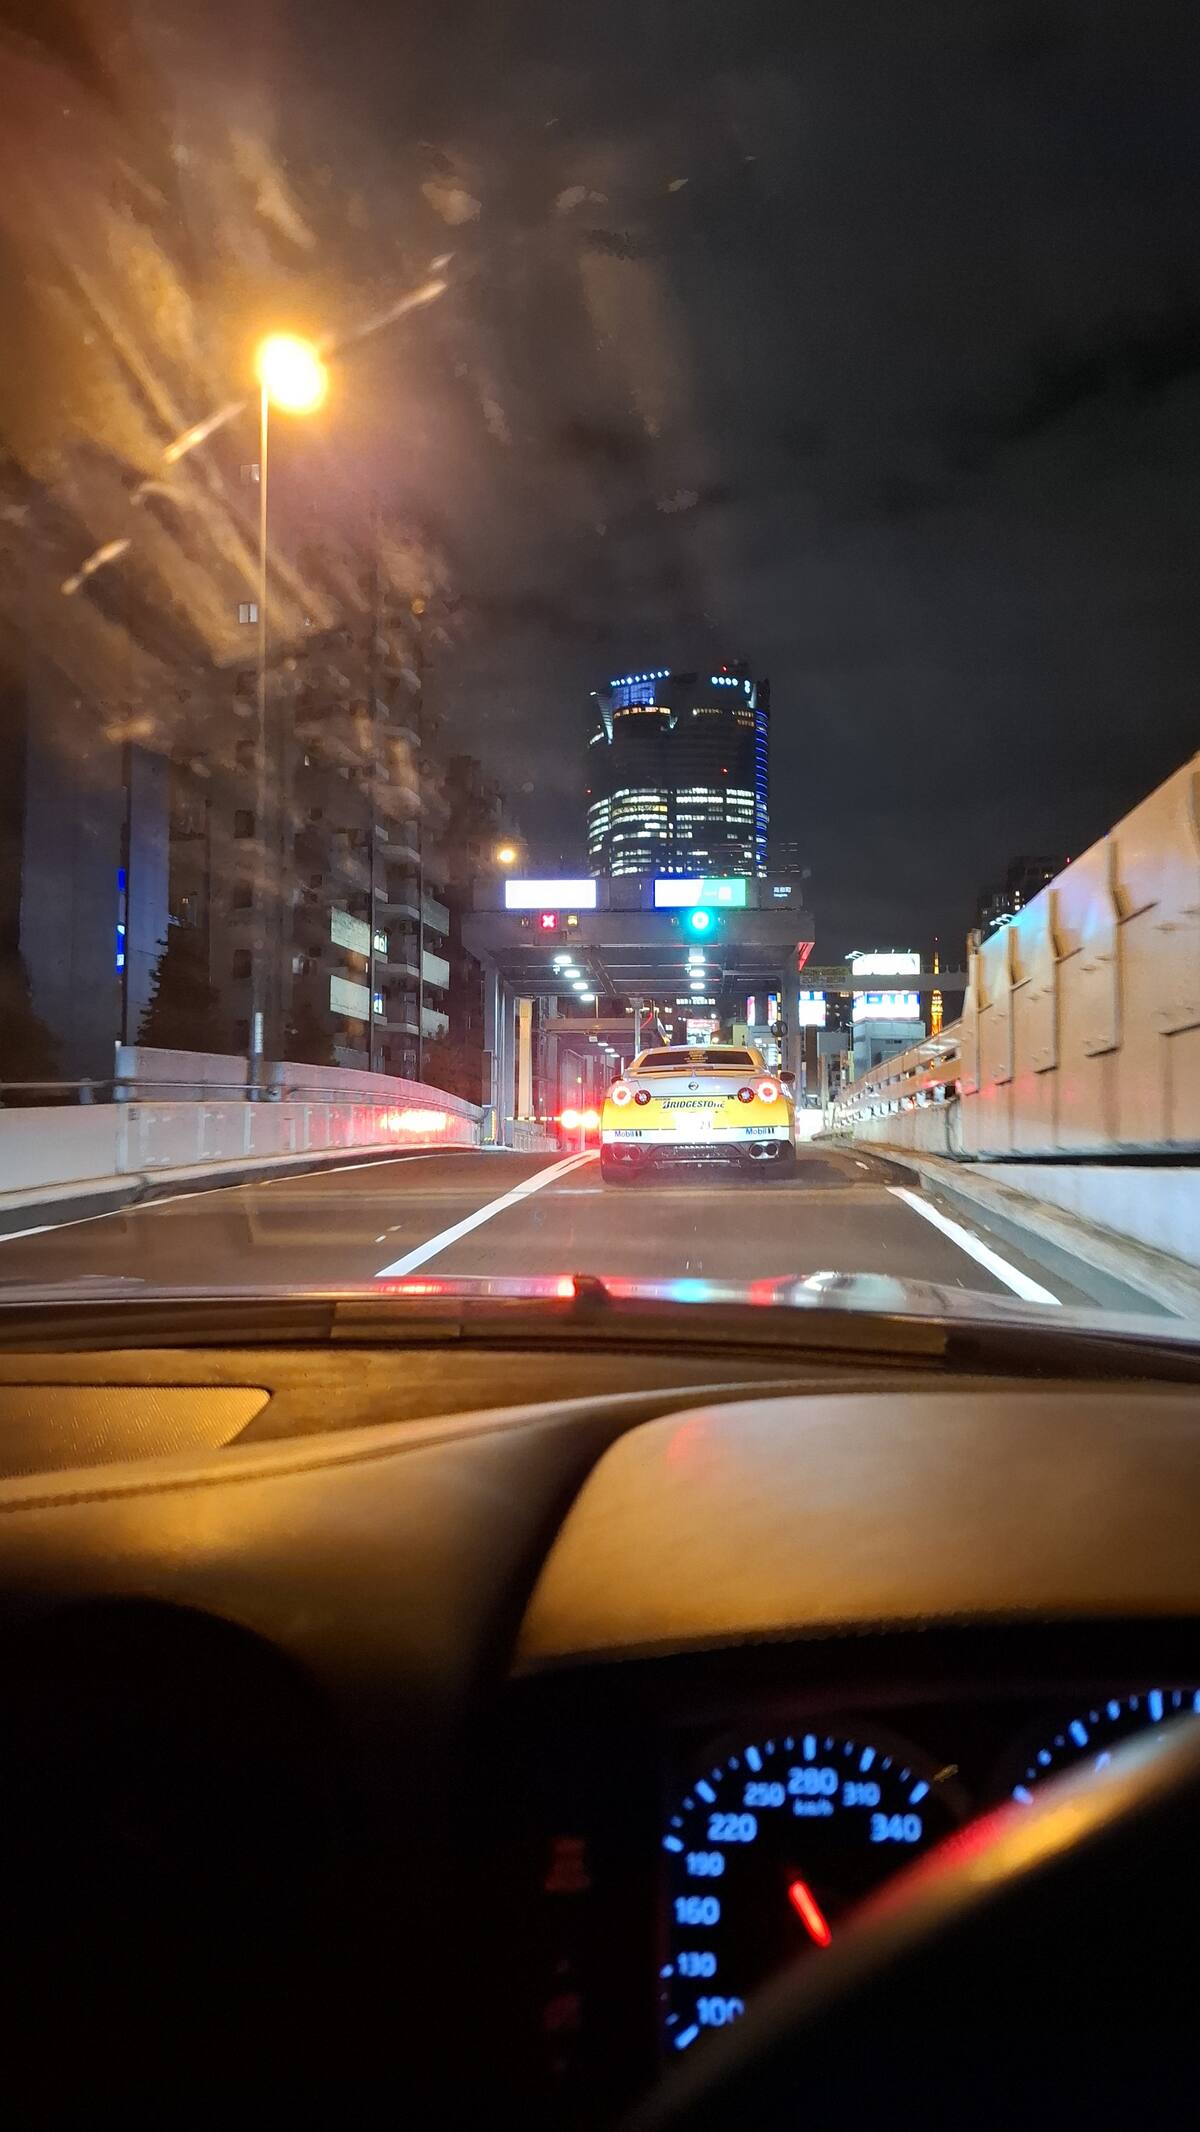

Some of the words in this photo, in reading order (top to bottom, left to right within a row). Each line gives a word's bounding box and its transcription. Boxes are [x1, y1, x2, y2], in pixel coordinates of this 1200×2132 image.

[788, 1767, 838, 1796] 280
[843, 1782, 880, 1806] 310
[744, 1782, 786, 1807] 250
[793, 1797, 834, 1816] km/h
[707, 1813, 757, 1842] 220
[870, 1813, 922, 1842] 340
[686, 1852, 725, 1877] 190
[675, 1896, 720, 1925] 160
[677, 1952, 716, 1977] 130
